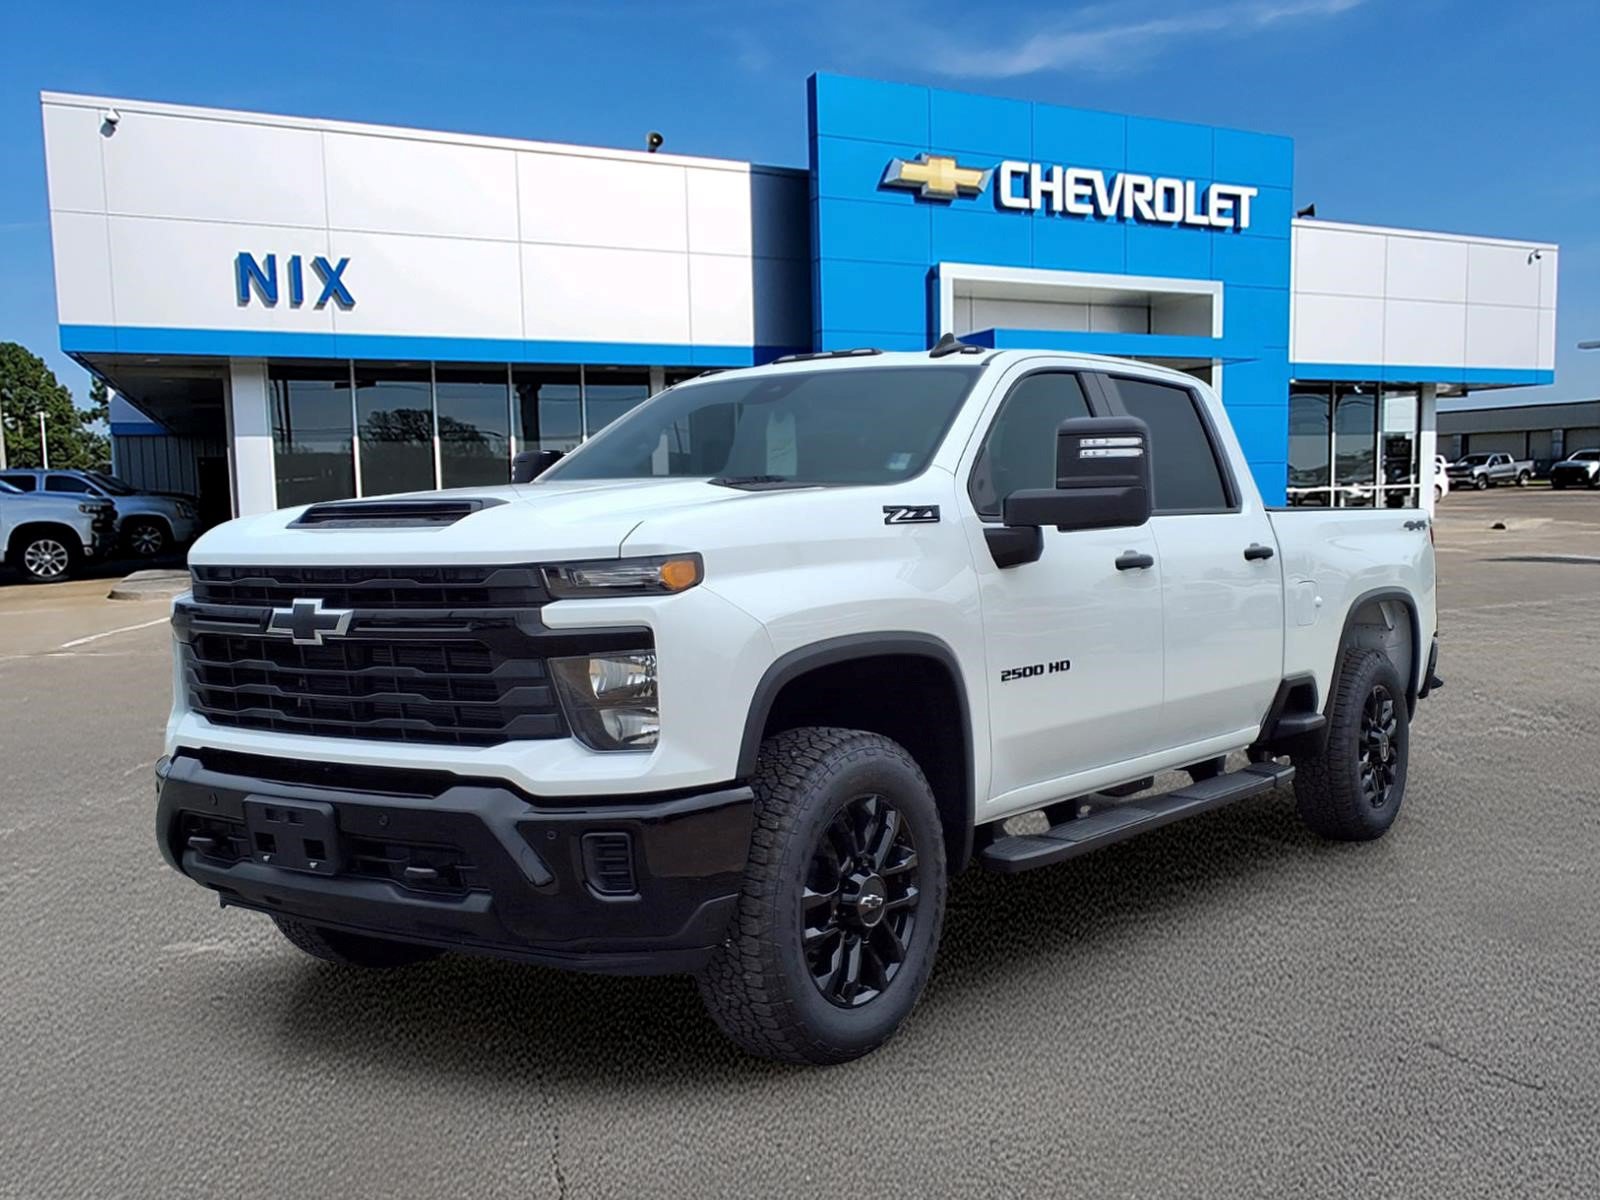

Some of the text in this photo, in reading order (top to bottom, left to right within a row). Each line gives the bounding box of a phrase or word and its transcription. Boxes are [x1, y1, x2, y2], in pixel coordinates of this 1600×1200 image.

[998, 160, 1257, 230] CHEVROLET
[234, 251, 356, 311] NIX
[1001, 660, 1071, 682] 2500 HD
